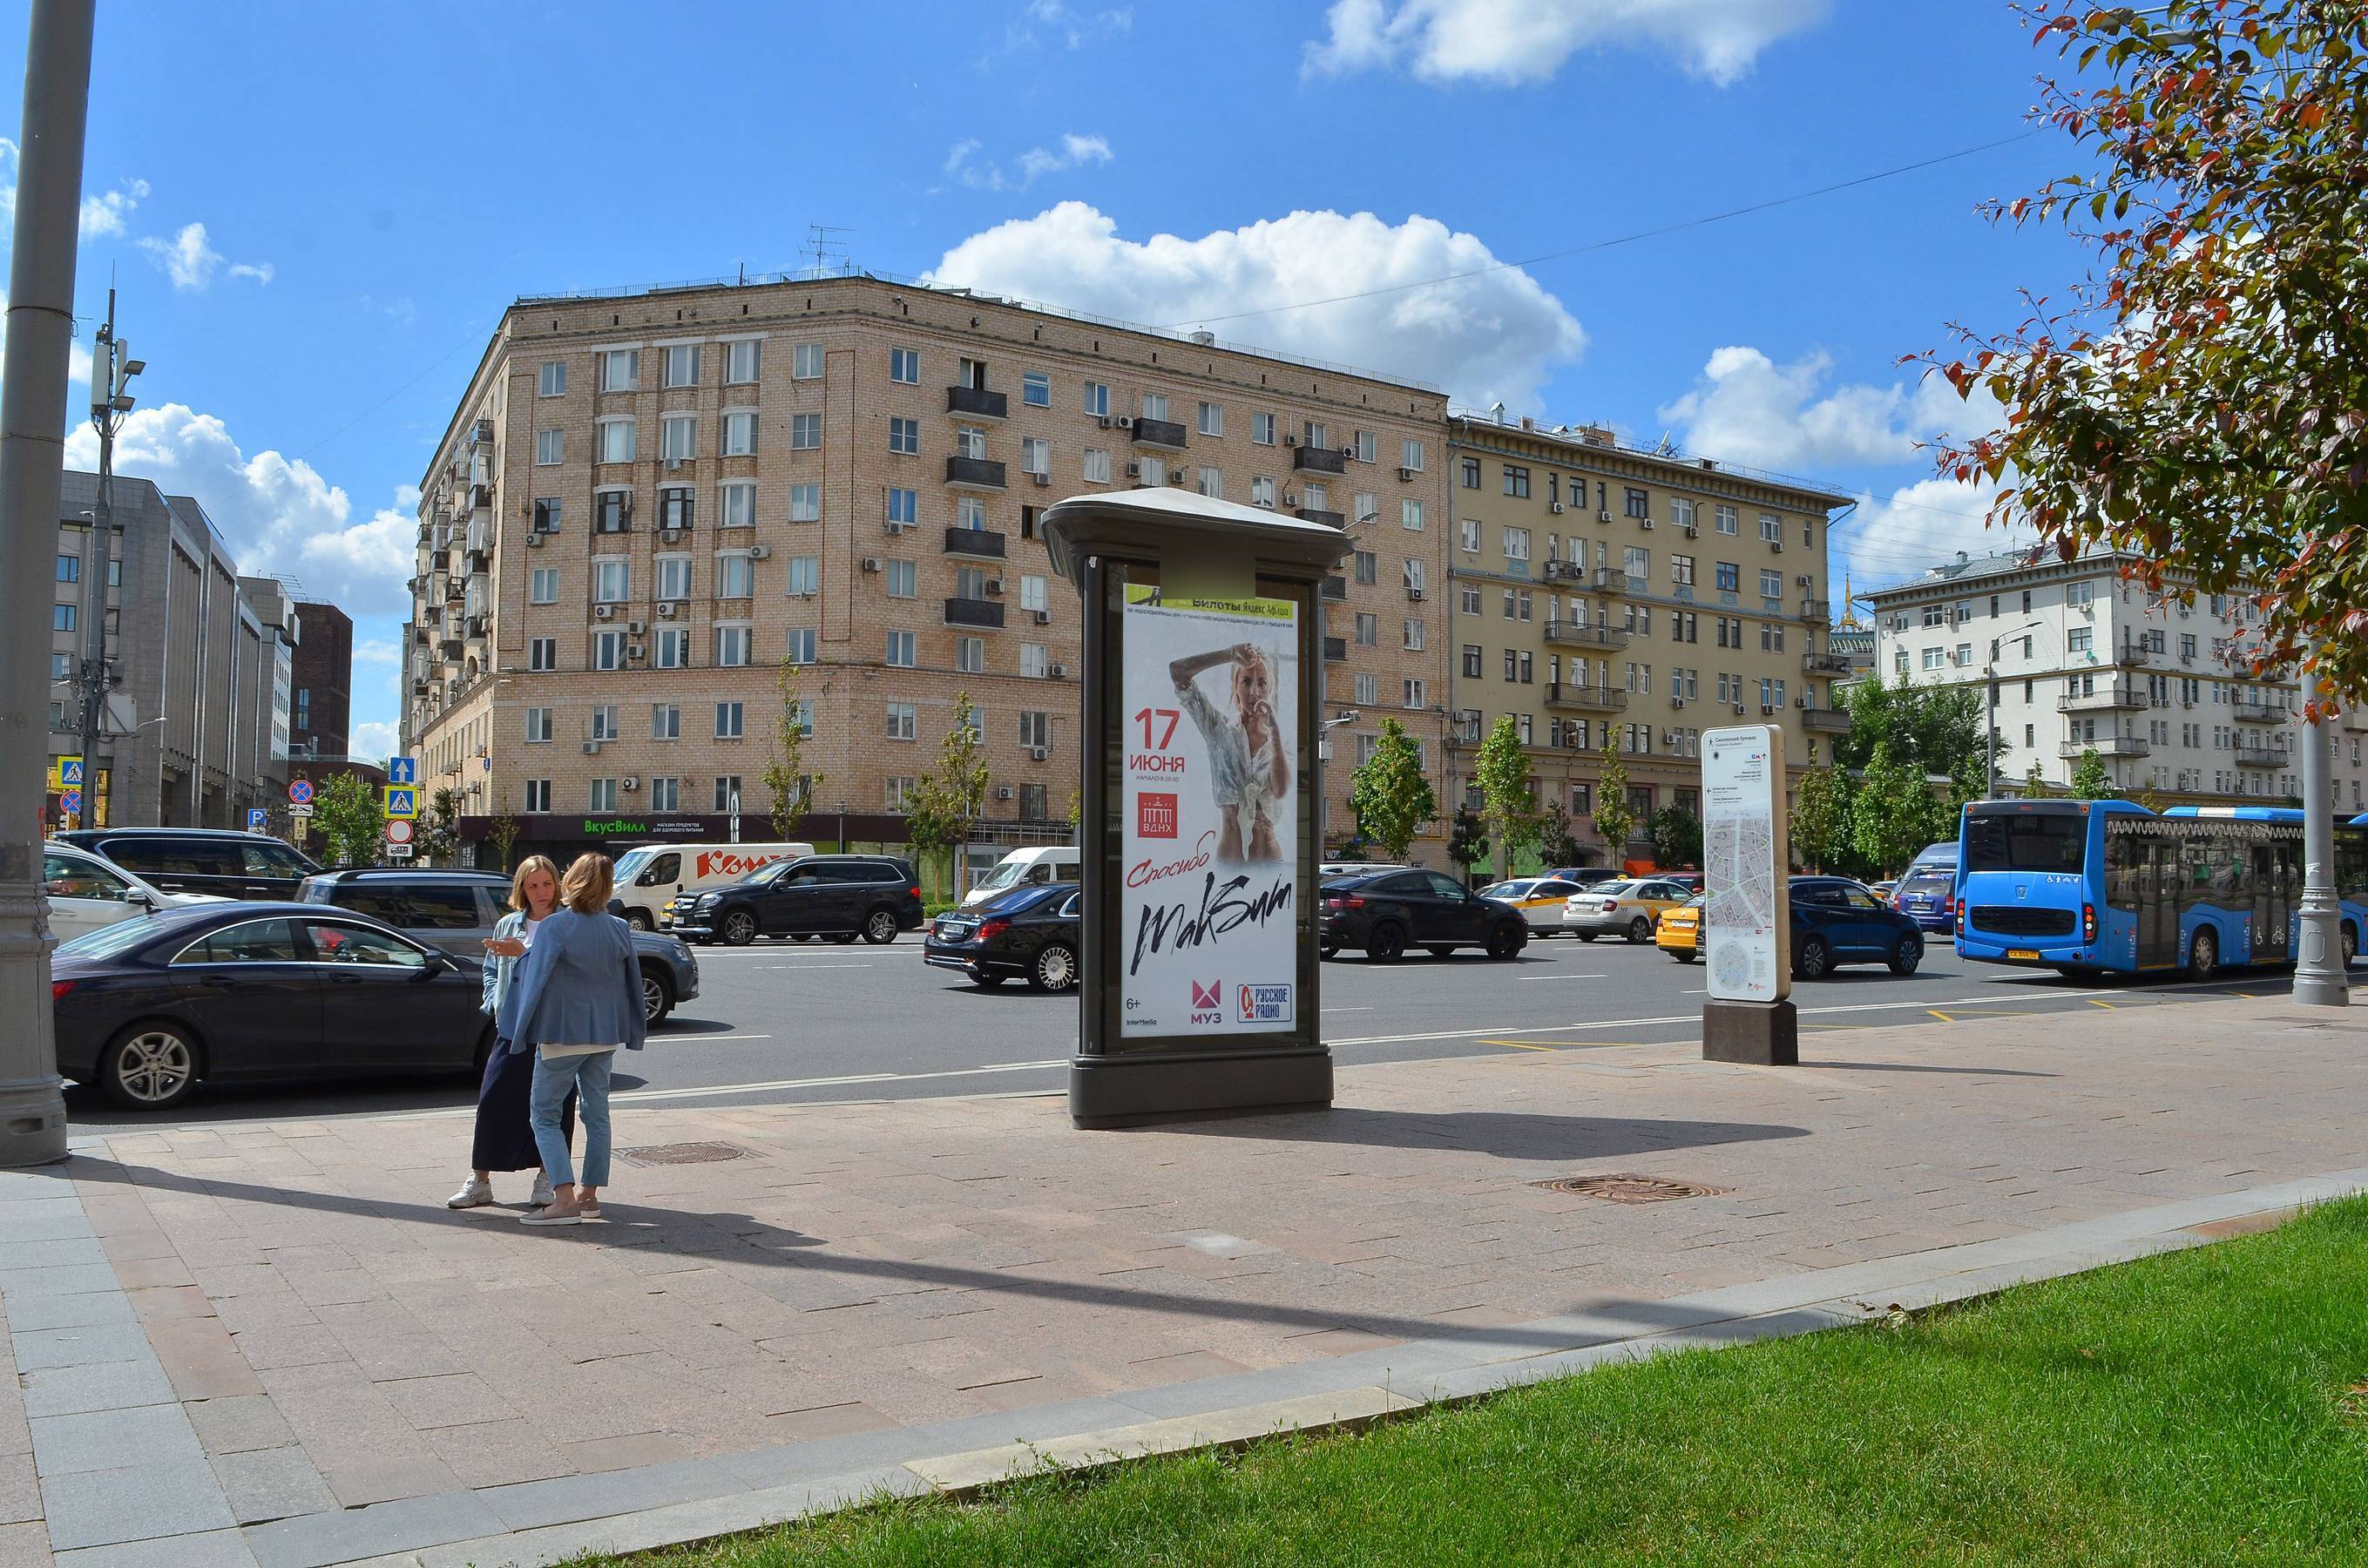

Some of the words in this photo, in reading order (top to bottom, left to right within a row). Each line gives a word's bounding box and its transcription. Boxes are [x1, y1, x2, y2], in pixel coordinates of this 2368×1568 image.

[1242, 602, 1266, 613] Яндекс
[1267, 604, 1289, 616] Афиша
[1134, 707, 1181, 750] 17
[1130, 754, 1185, 773] ИЮНЯ
[585, 820, 646, 835] ВкусВилл
[1143, 823, 1172, 832] ВДНХ
[697, 850, 795, 878] Ком
[1126, 830, 1215, 888] Спасибо
[1255, 988, 1288, 1003] РУССКОЕ
[1126, 997, 1140, 1010] 6+
[1255, 1004, 1280, 1018] РАДИО
[1191, 1012, 1221, 1024] МУЗ
